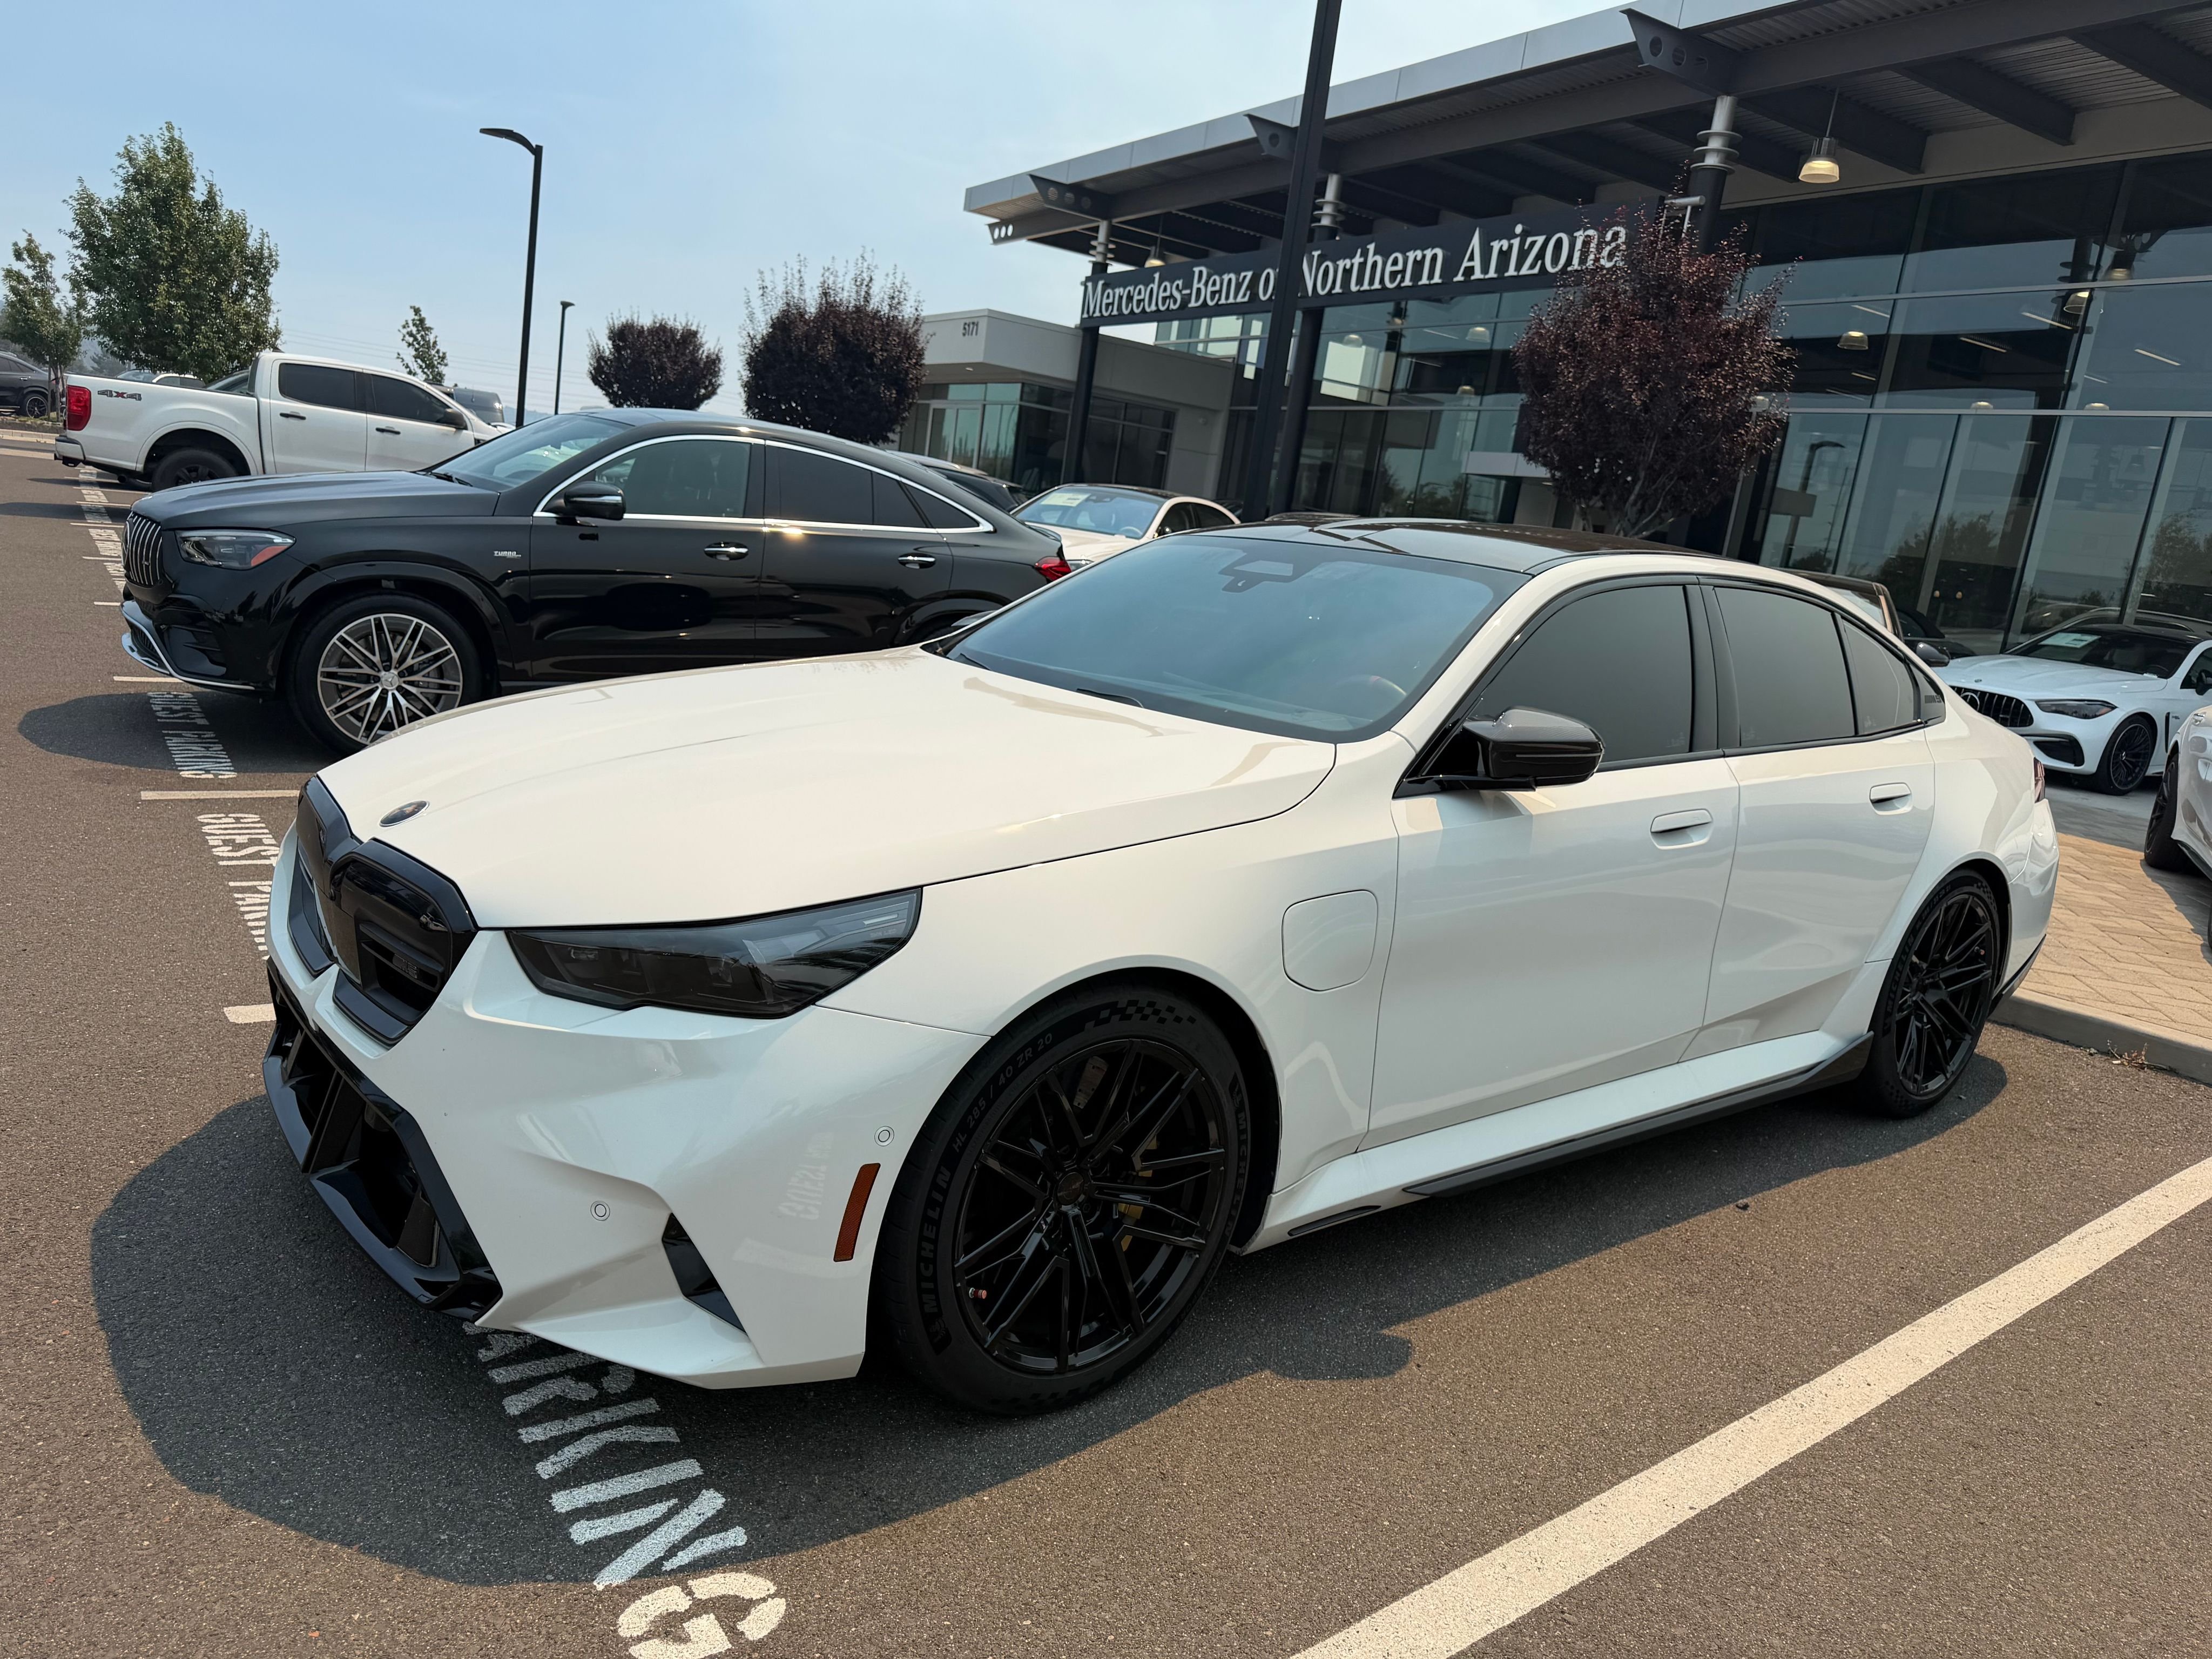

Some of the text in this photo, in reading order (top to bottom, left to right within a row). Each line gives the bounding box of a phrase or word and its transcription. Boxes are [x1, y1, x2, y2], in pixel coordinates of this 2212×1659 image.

[1082, 224, 1626, 319] Mercedes-Benz o Northern Arizona
[962, 321, 979, 337] 5171
[147, 692, 238, 778] GUEST PARKING
[197, 813, 280, 866] GUEST
[920, 1167, 952, 1314] MICHELIN
[967, 1097, 986, 1129] 285
[999, 1065, 1014, 1087] 40
[1016, 1047, 1034, 1068] ZR
[1037, 1033, 1053, 1052] 20
[1224, 1111, 1247, 1237] MICHELIN
[462, 1321, 787, 1658] RKING
